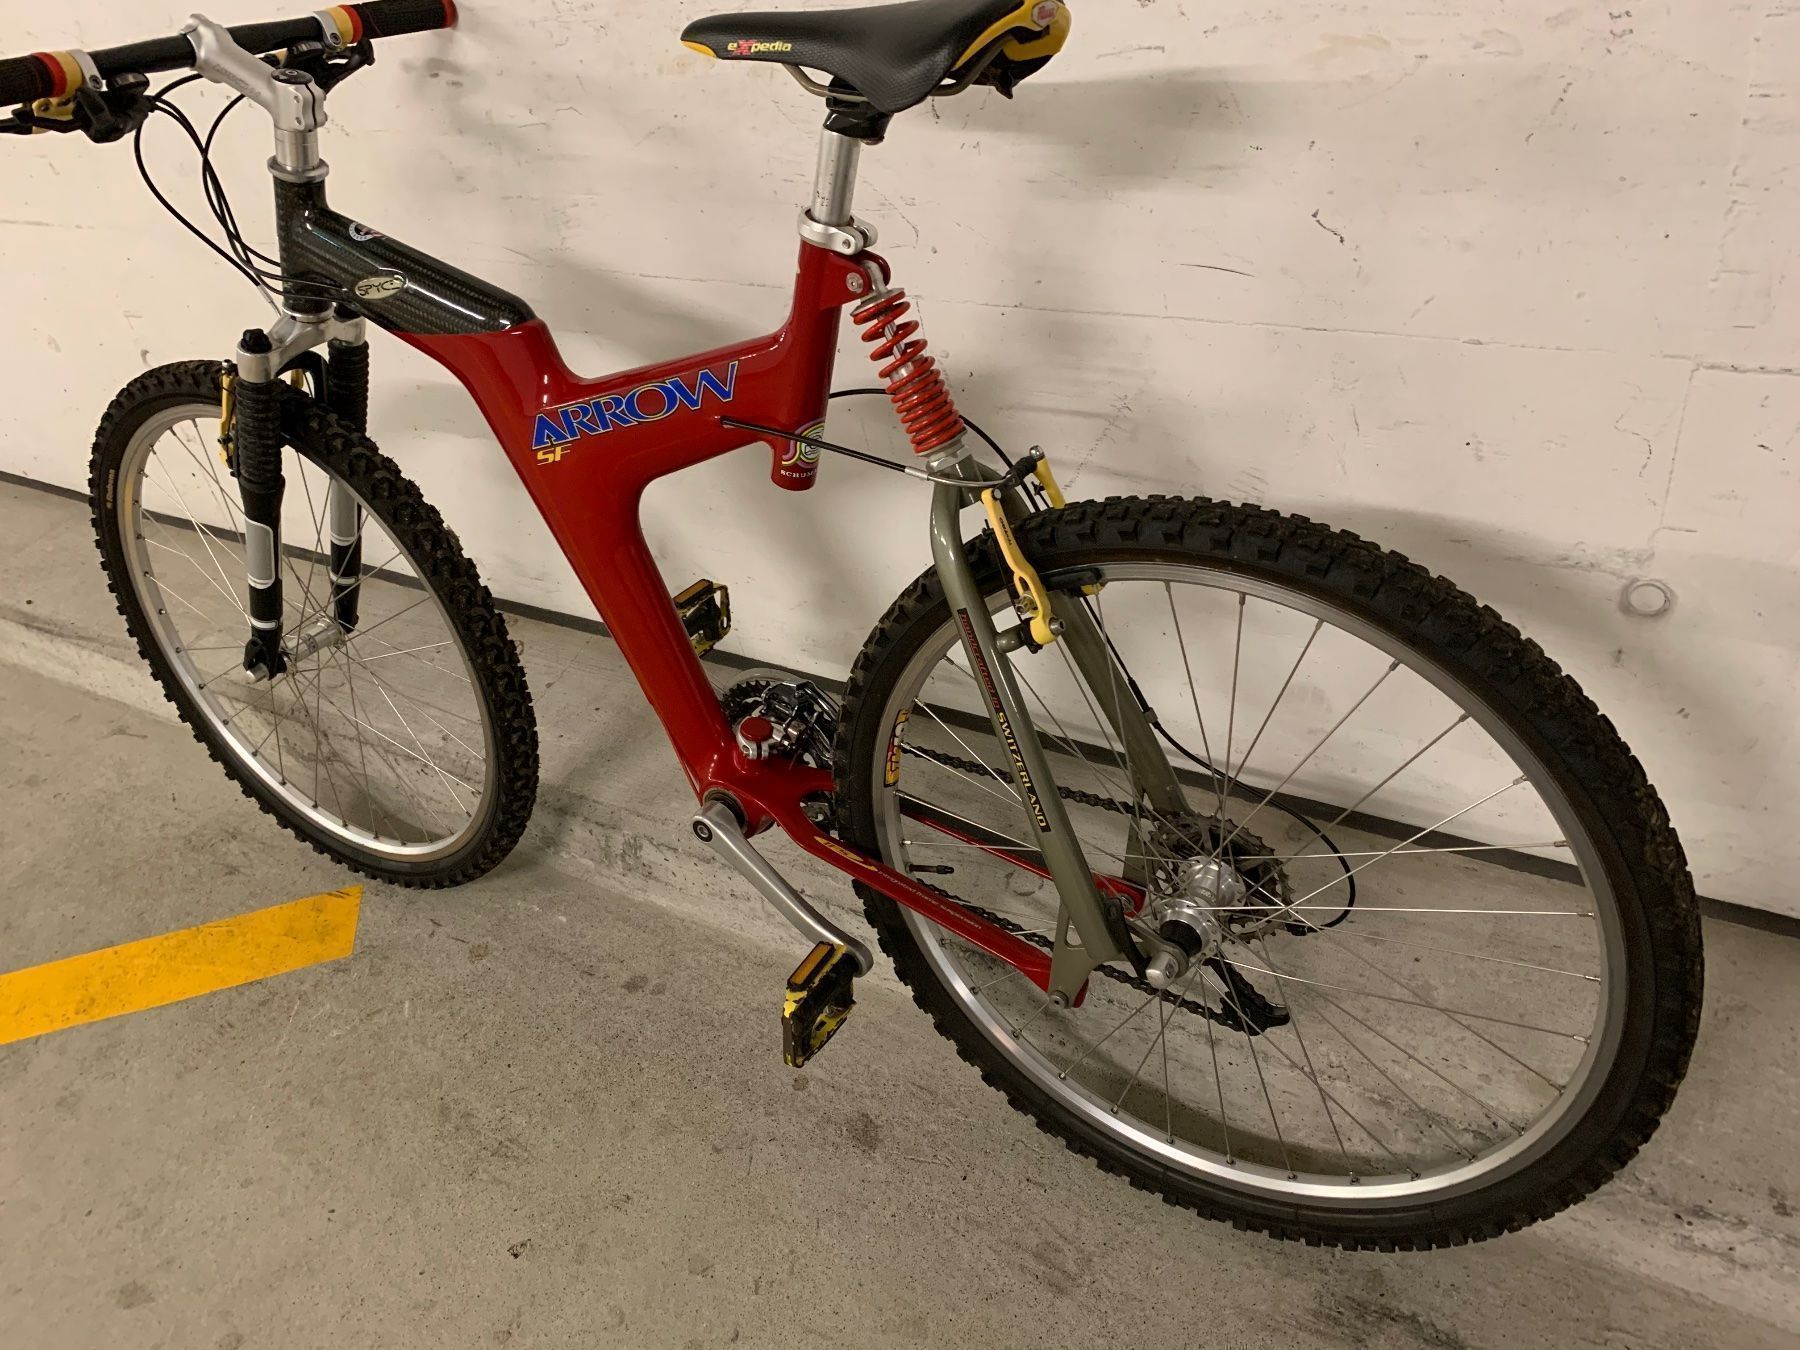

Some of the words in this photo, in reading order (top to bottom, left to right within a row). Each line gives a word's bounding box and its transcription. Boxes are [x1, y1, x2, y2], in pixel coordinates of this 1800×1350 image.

[531, 361, 739, 449] ARROW
[537, 444, 573, 466] SF
[997, 712, 1047, 827] SWITZERLAND
